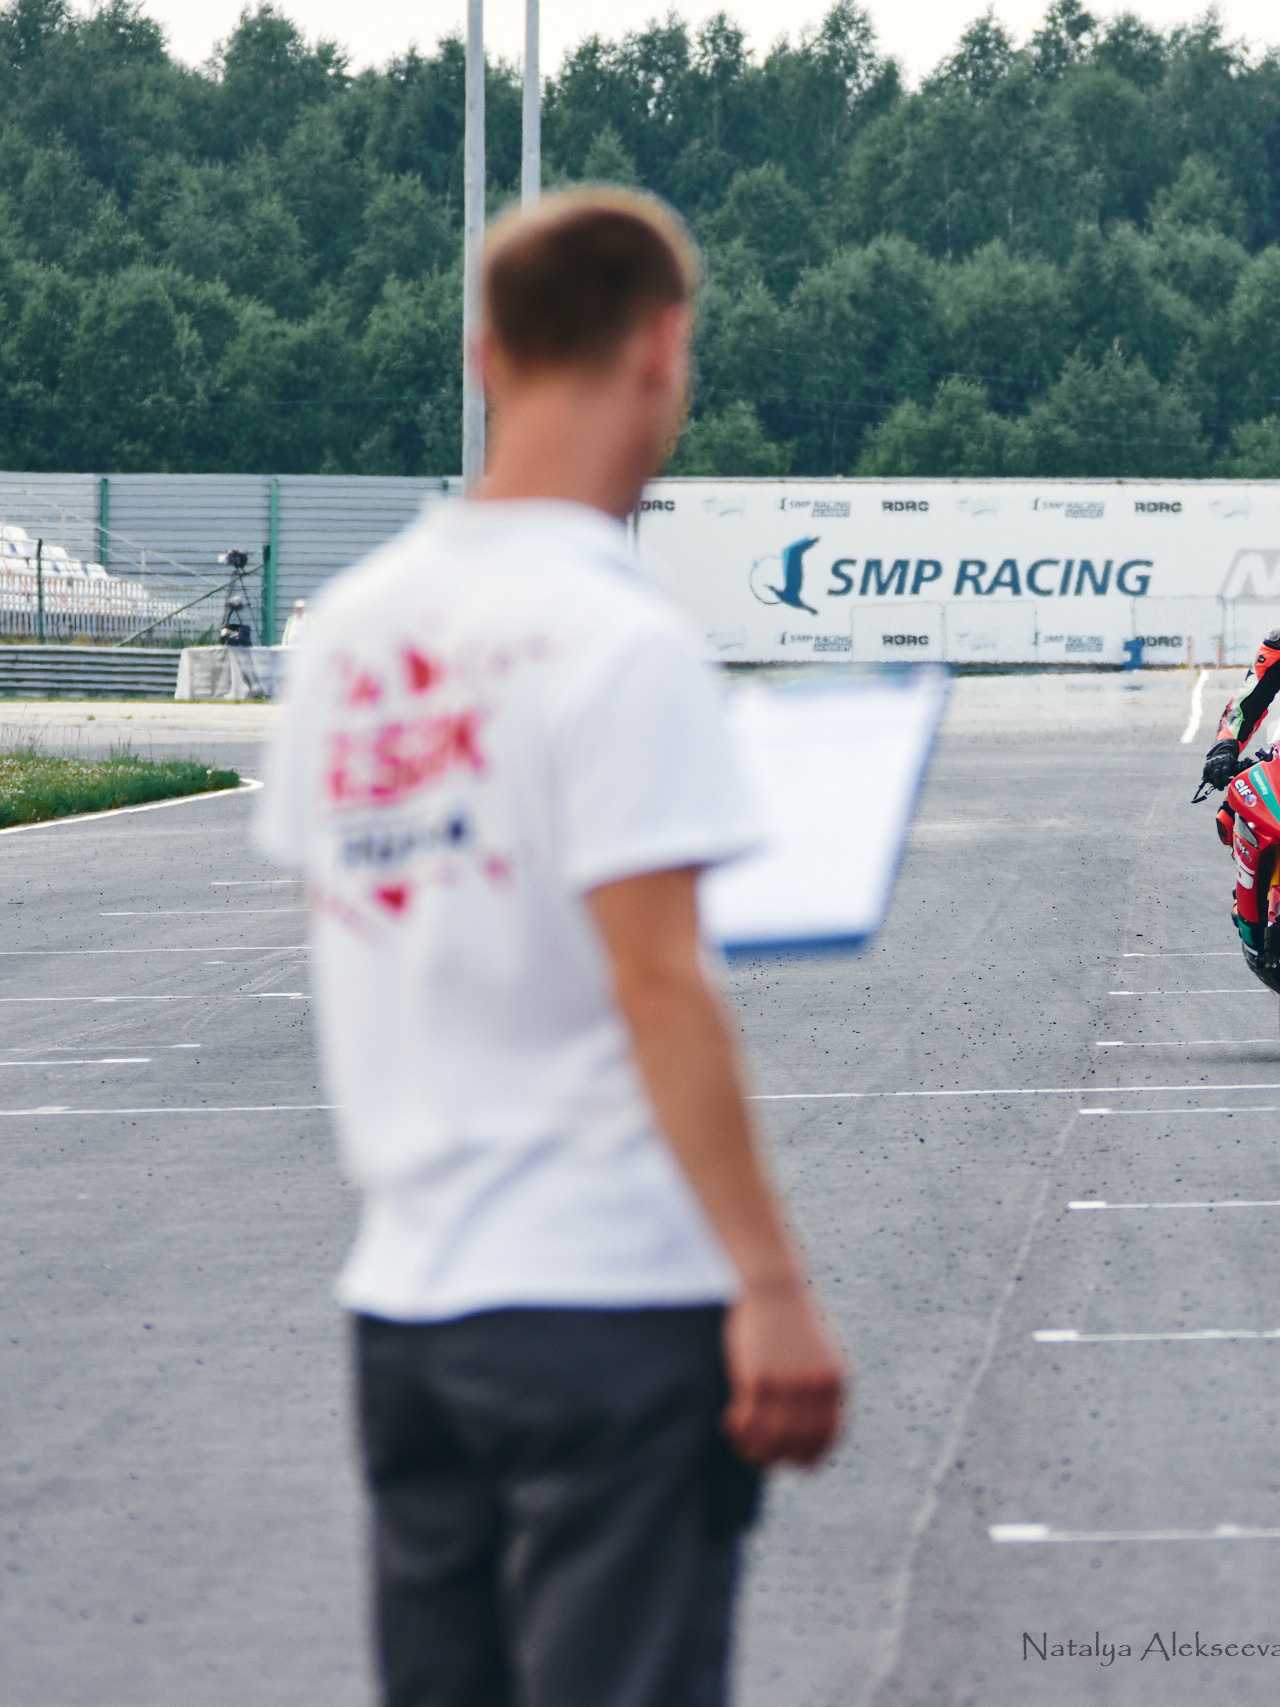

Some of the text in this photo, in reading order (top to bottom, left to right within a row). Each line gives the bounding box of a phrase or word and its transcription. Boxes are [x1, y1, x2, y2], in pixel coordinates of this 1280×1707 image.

[639, 500, 675, 512] DRC
[827, 559, 1154, 597] SMP RACING
[1234, 779, 1252, 798] elf
